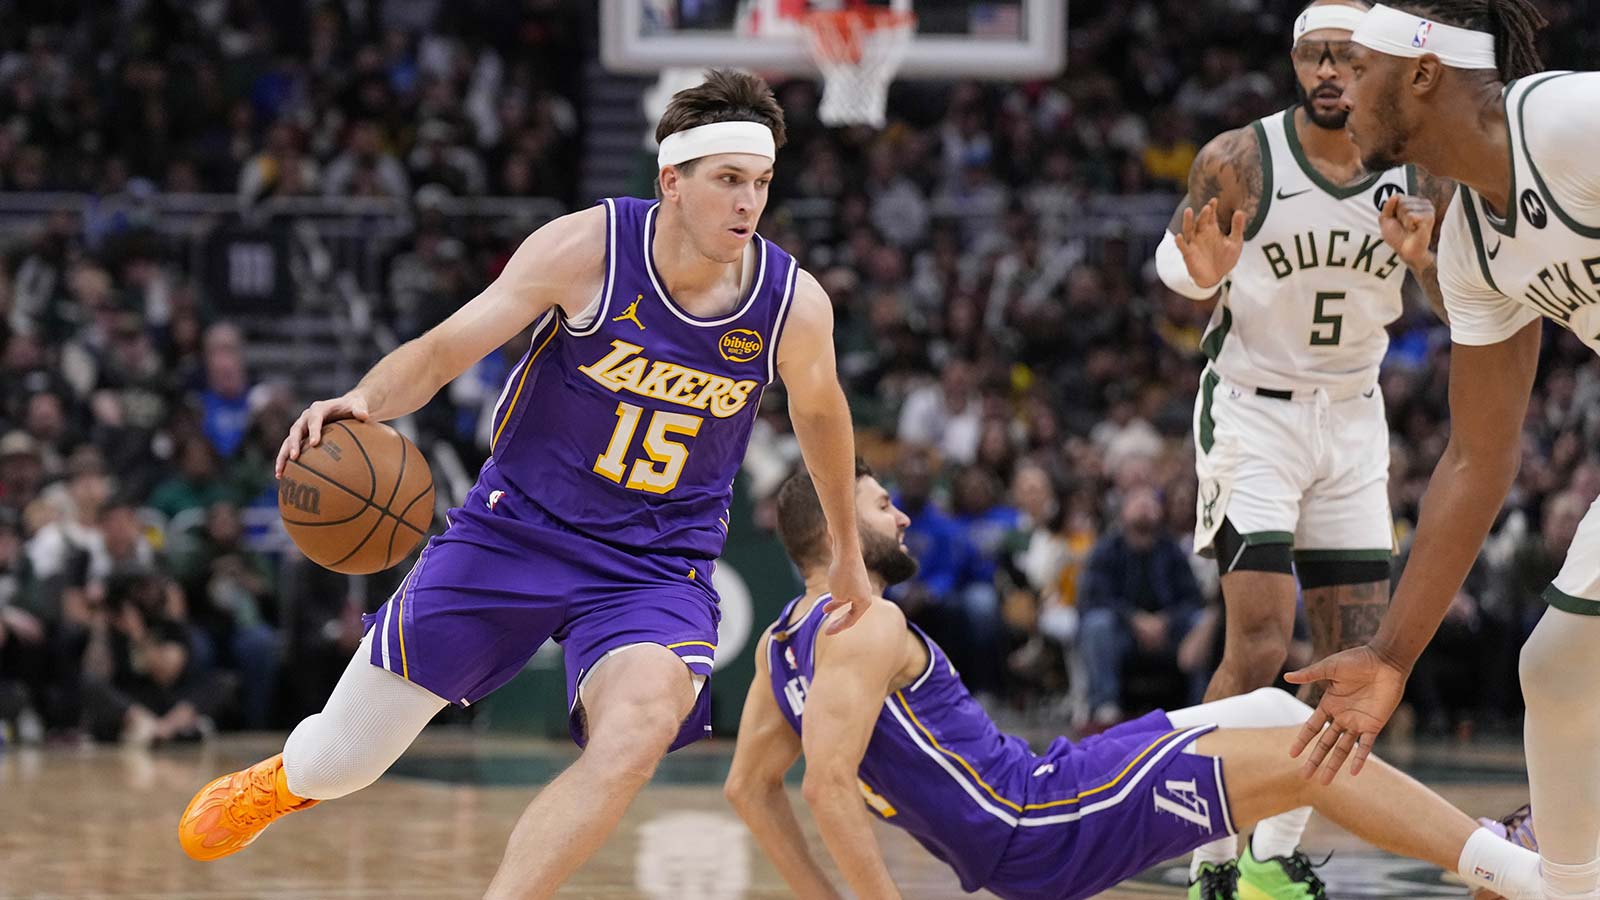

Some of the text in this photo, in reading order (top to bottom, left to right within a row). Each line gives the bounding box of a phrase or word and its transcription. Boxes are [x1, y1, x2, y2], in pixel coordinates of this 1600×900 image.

[723, 336, 760, 353] bibigo
[1310, 292, 1346, 346] 5
[577, 339, 758, 418] LAKERS
[593, 401, 703, 494] 15
[1153, 778, 1212, 835] LA
